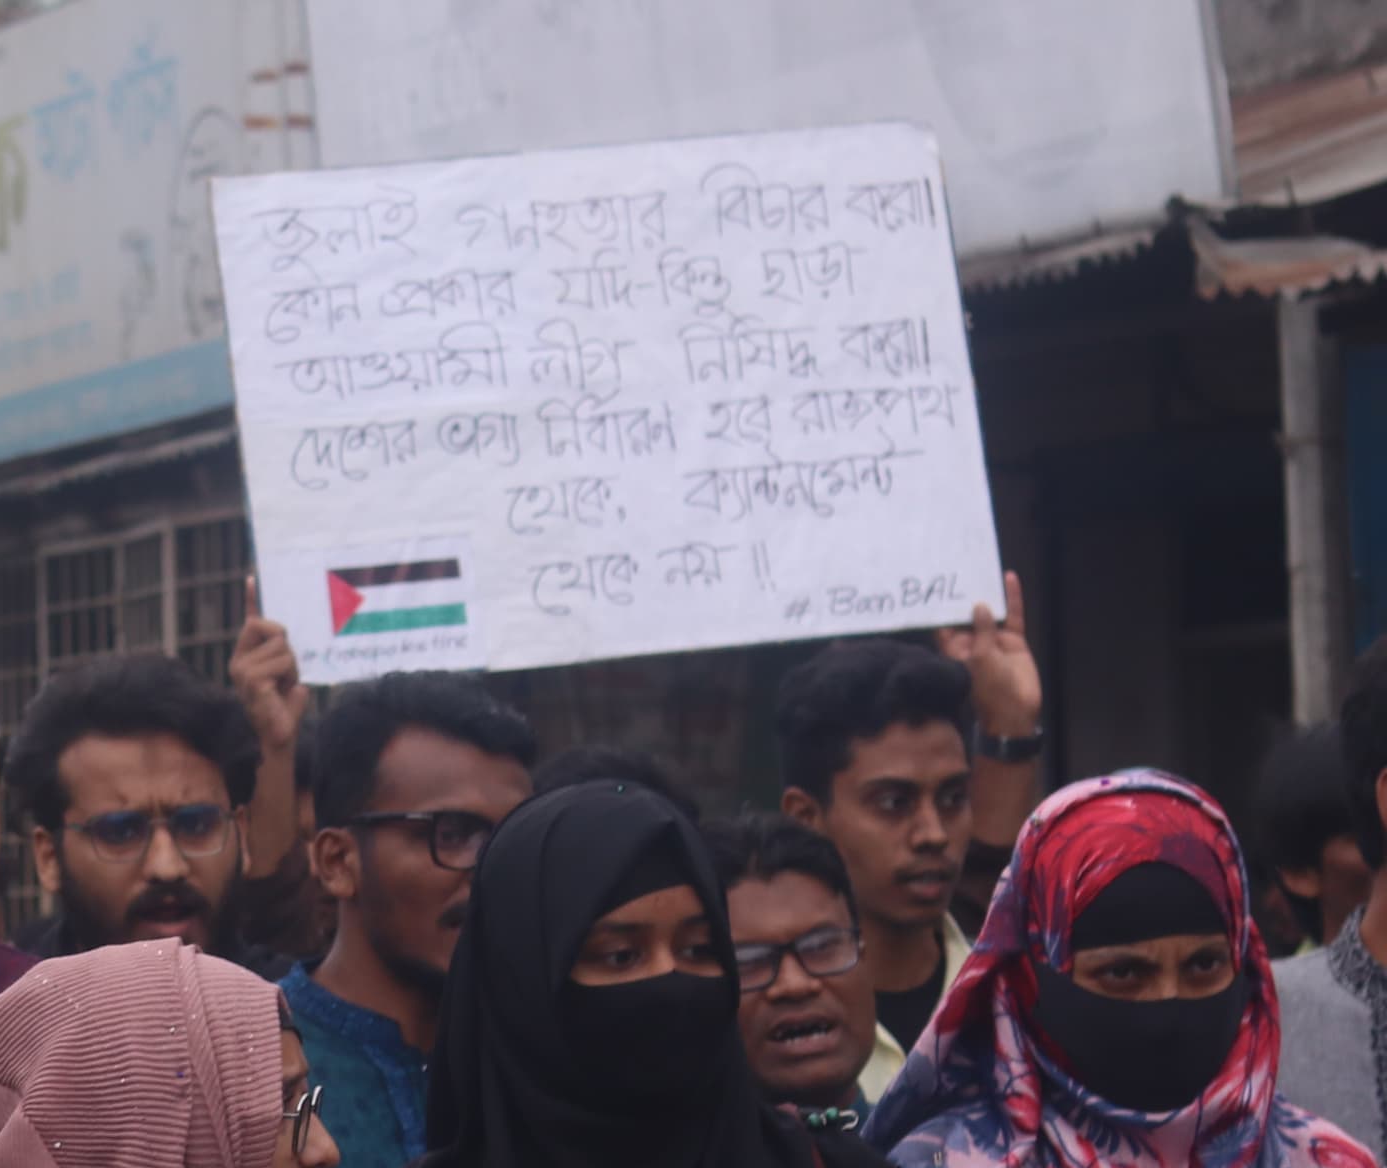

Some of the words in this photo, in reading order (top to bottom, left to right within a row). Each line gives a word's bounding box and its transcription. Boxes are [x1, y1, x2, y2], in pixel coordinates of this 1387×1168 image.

[251, 184, 419, 281] জুলাই
[700, 162, 830, 237] বিচার
[264, 283, 362, 345] কোন
[379, 267, 517, 319] প্রকার
[761, 240, 867, 303] ছাড়া
[273, 320, 508, 400] আওয়ামী
[526, 317, 636, 394] লীগ
[290, 418, 419, 490] দেশের
[705, 393, 773, 446] হবে
[790, 383, 960, 435] রাজপথ
[528, 553, 639, 617] থেকে
